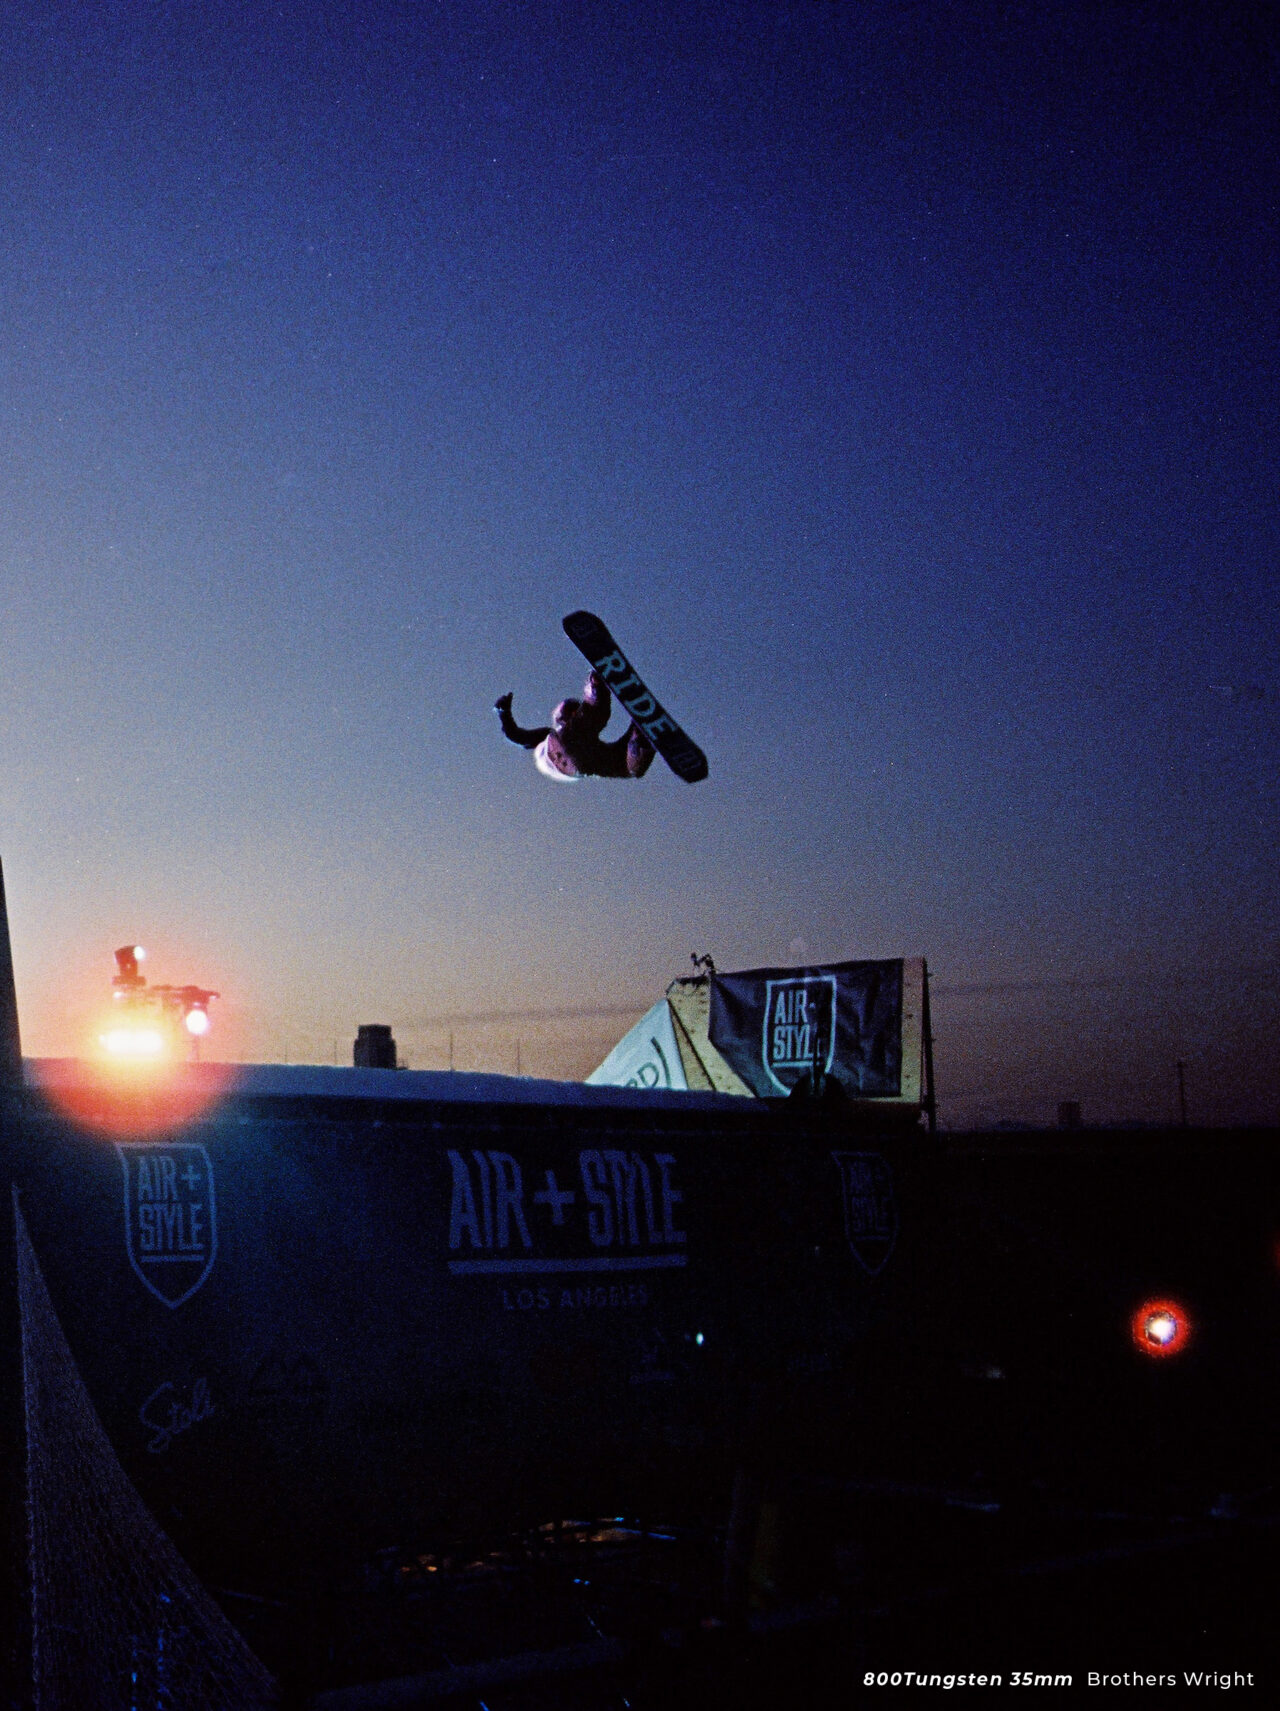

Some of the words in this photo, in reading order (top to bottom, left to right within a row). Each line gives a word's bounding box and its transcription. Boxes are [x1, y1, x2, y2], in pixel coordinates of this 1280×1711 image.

[594, 649, 679, 741] RIDE
[139, 1203, 205, 1252] STYLE
[503, 1287, 551, 1311] LOS
